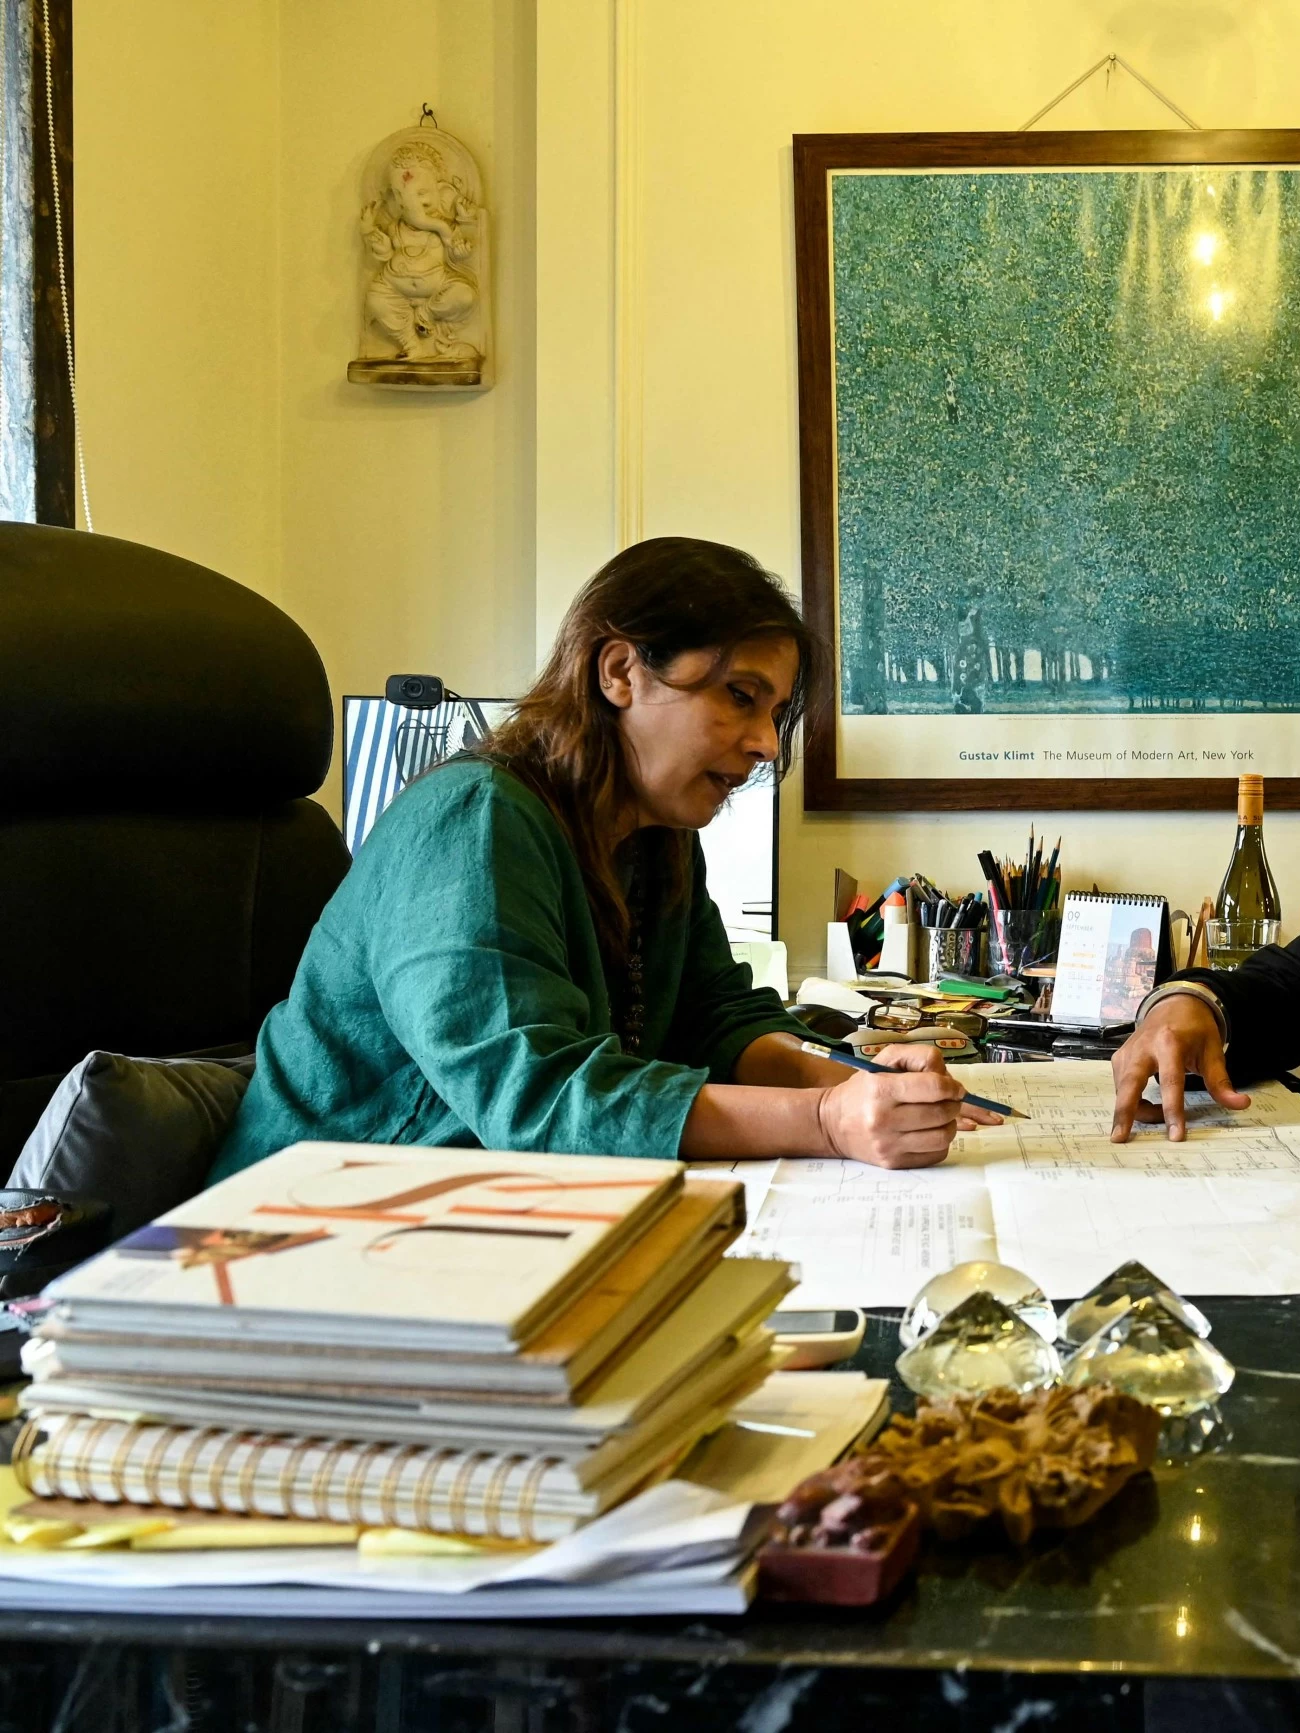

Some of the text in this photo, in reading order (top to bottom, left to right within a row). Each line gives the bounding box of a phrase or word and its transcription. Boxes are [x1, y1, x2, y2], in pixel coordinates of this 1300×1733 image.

[958, 750, 1255, 763] Gustav Klimt The Museum of Modern Art, New York
[1067, 911, 1081, 922] 09
